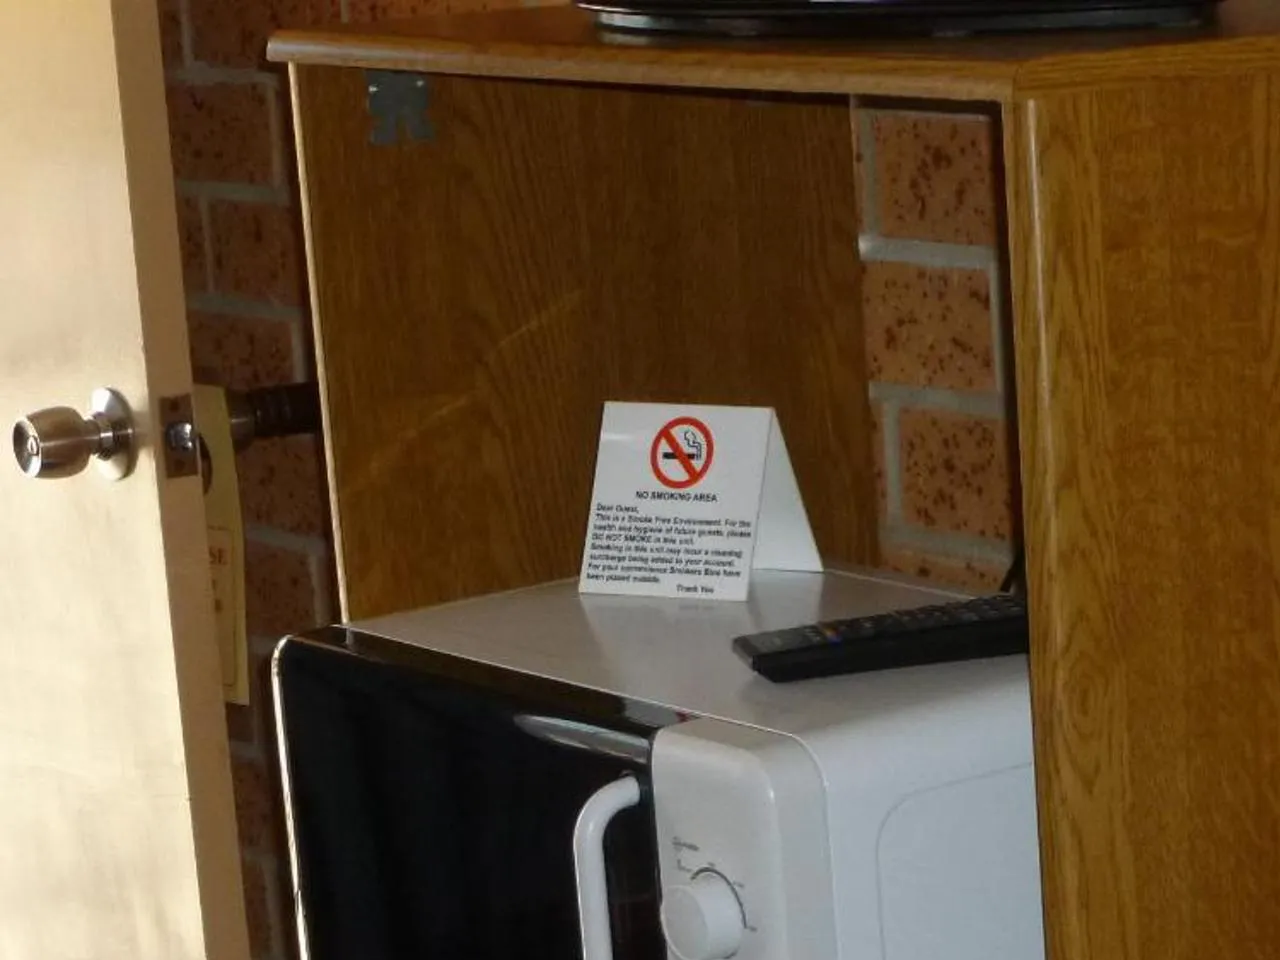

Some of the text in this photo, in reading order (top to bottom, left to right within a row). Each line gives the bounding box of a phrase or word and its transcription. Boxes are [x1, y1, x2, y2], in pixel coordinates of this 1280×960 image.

[636, 491, 718, 502] NO SMOKING AREA
[597, 502, 614, 511] Dear
[595, 513, 611, 521] This
[627, 515, 653, 523] Smoke
[655, 516, 671, 525] Free
[725, 518, 737, 527] For
[739, 520, 751, 528] the
[634, 525, 663, 535] hygiene
[674, 527, 696, 536] future
[592, 532, 604, 541] DO
[605, 533, 623, 542] NOT
[624, 535, 652, 543] SMOKE
[590, 542, 623, 552] Smoking
[666, 548, 681, 556] may
[627, 555, 649, 564] being
[675, 557, 684, 565] to
[685, 558, 702, 567] your
[586, 571, 604, 580] been
[588, 562, 601, 570] For
[602, 564, 619, 572] your
[723, 569, 741, 578] have
[676, 584, 698, 594] Thank
